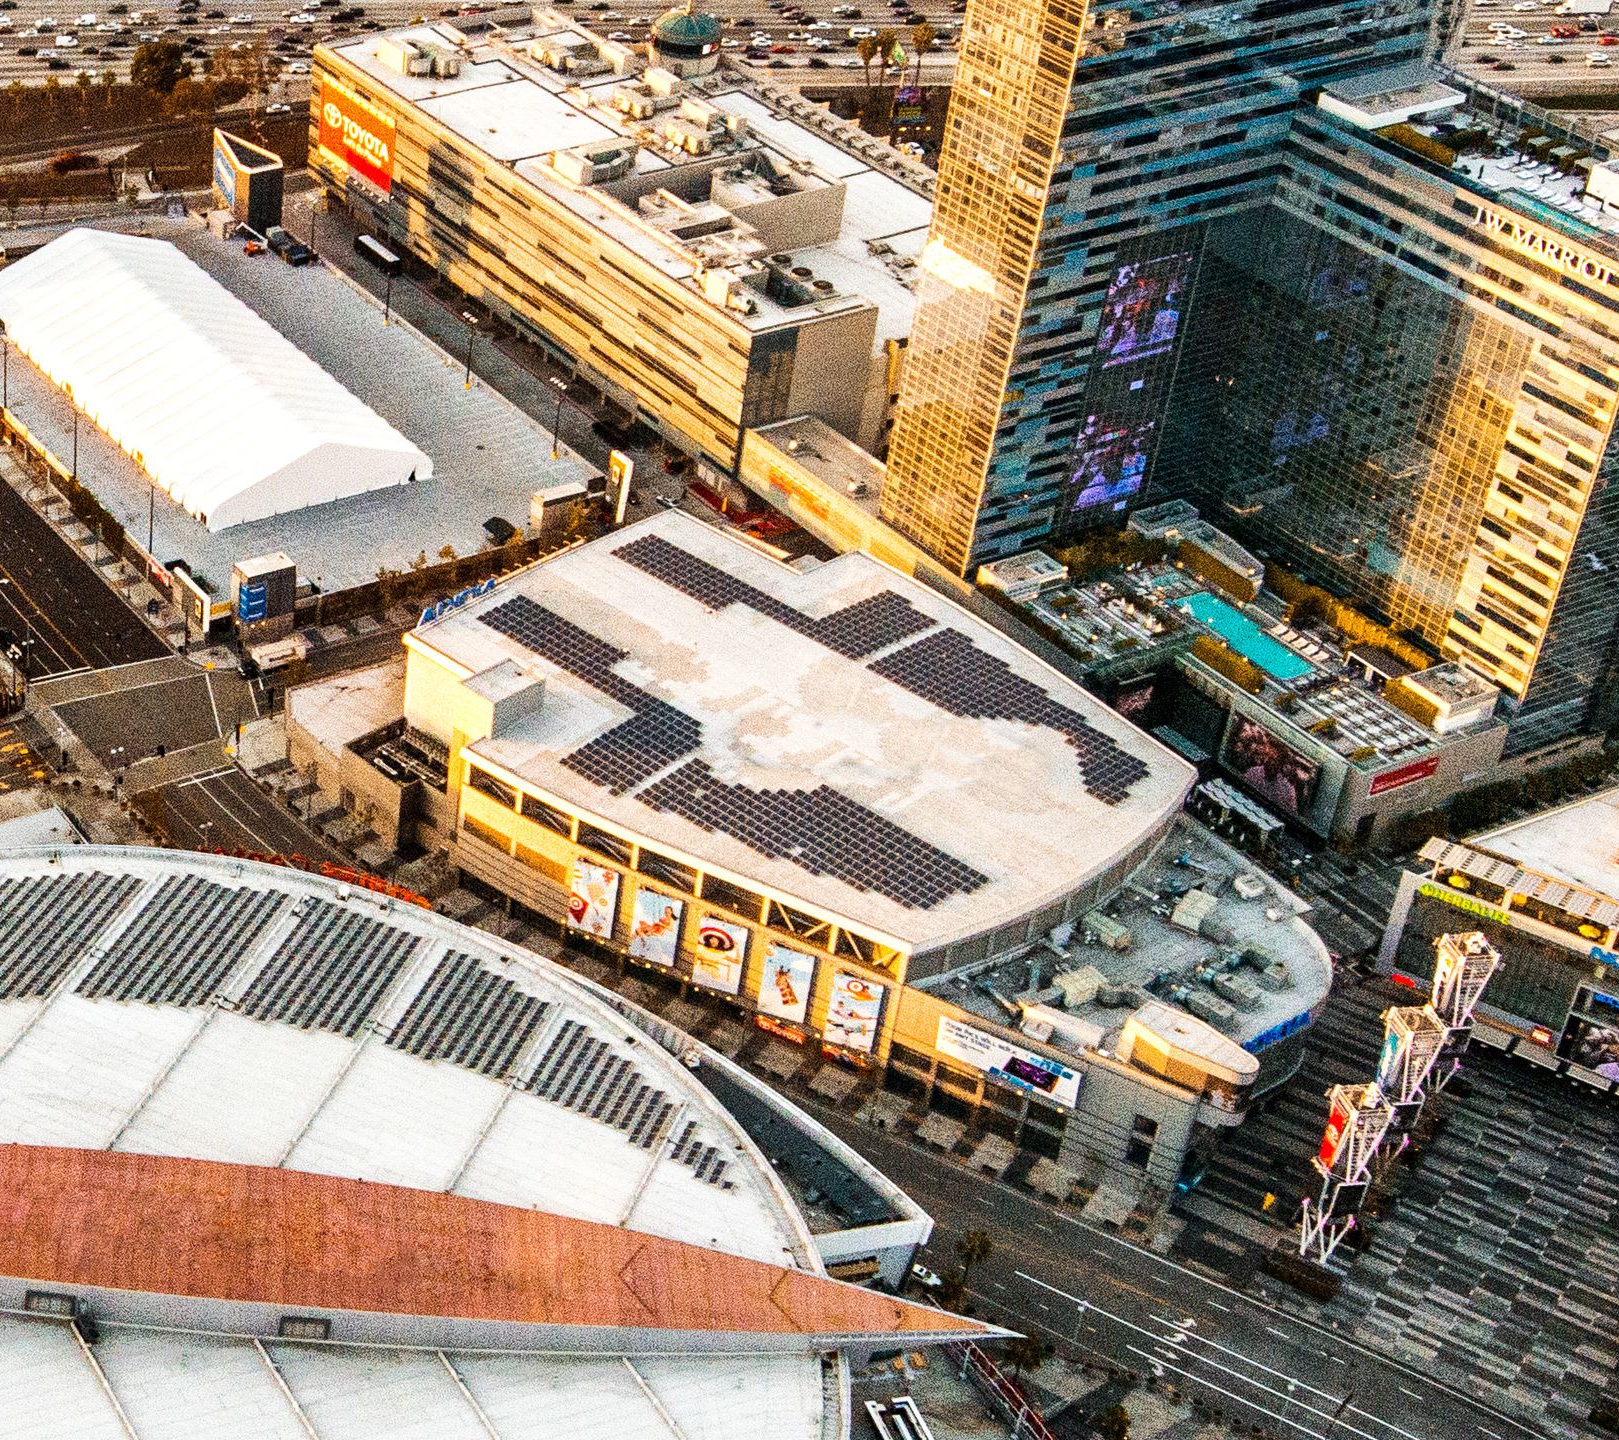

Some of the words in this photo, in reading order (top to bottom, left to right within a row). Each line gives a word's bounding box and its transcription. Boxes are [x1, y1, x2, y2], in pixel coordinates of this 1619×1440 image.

[342, 114, 389, 162] TOYOTA
[1472, 205, 1507, 238] JW
[1435, 887, 1511, 925] HERBALIFE
